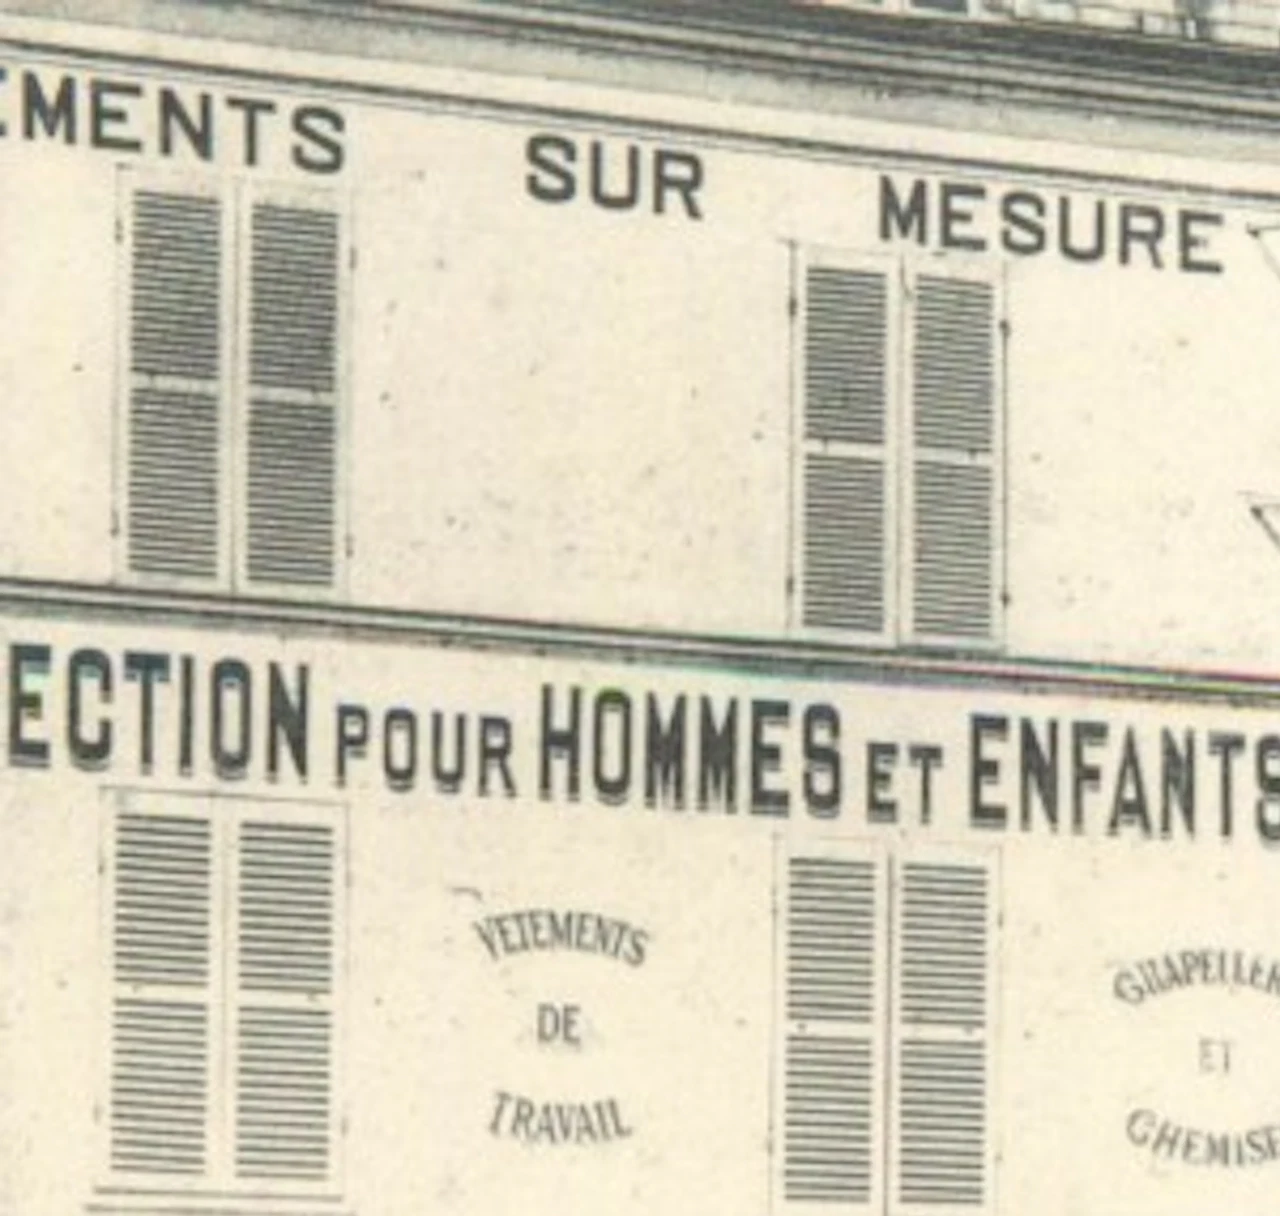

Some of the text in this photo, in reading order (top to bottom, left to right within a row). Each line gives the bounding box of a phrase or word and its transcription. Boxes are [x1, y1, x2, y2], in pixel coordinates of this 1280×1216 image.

[0, 66, 1224, 275] MENTS SUR MESURE
[335, 703, 517, 798] POUR
[538, 683, 843, 818] HOMMES
[866, 741, 943, 824] ET
[473, 907, 651, 967] VETEMENTS
[536, 1002, 582, 1047] DE
[1197, 1036, 1234, 1075] ET
[488, 1090, 633, 1144] TRAVAIL
